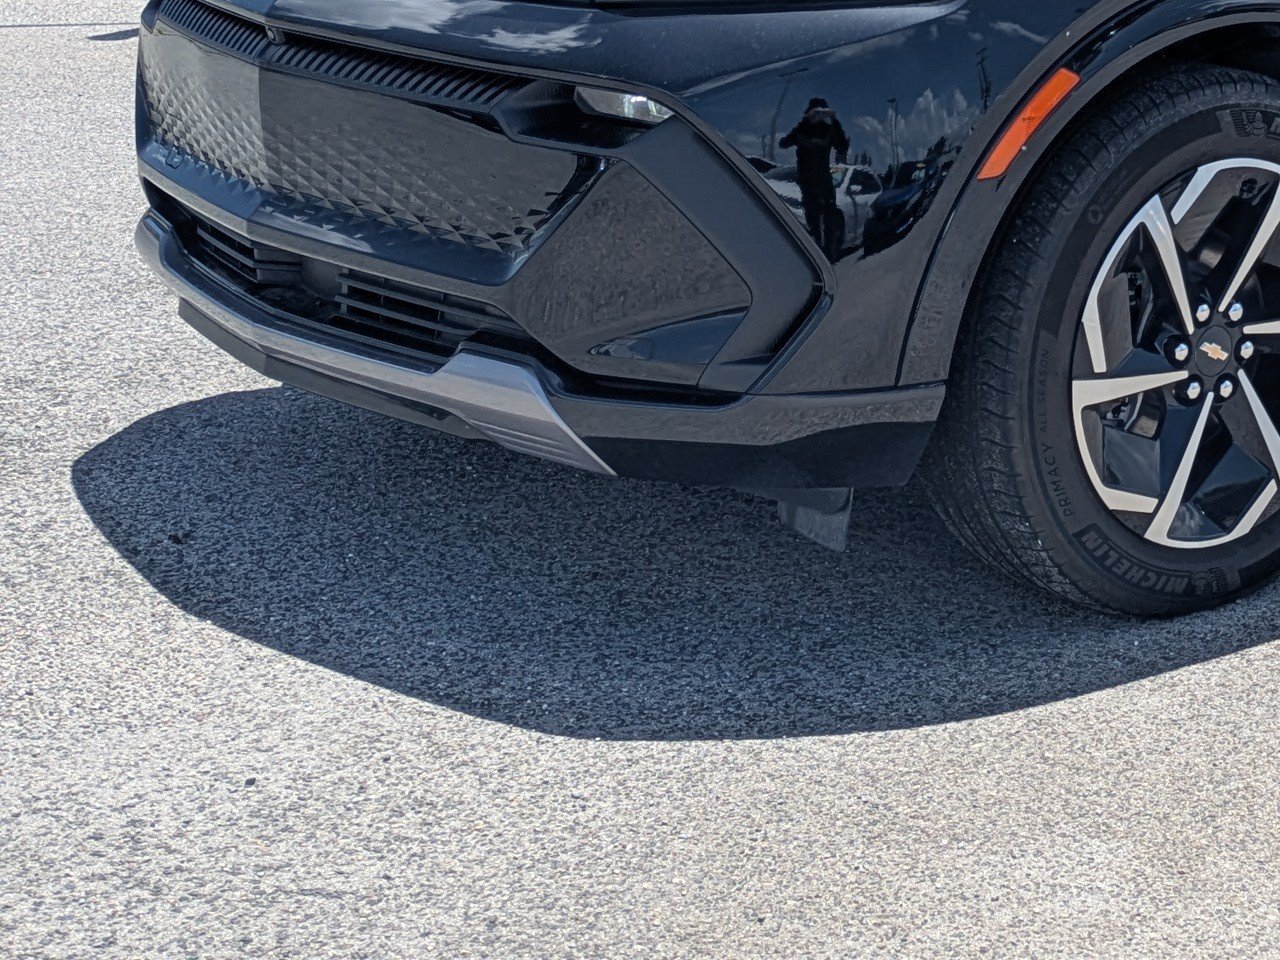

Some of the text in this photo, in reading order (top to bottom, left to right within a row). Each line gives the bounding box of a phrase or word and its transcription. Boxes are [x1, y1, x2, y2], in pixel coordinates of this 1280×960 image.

[1037, 349, 1075, 519] PRIMACY ALL SEASON
[1080, 530, 1188, 594] MICHELIN
